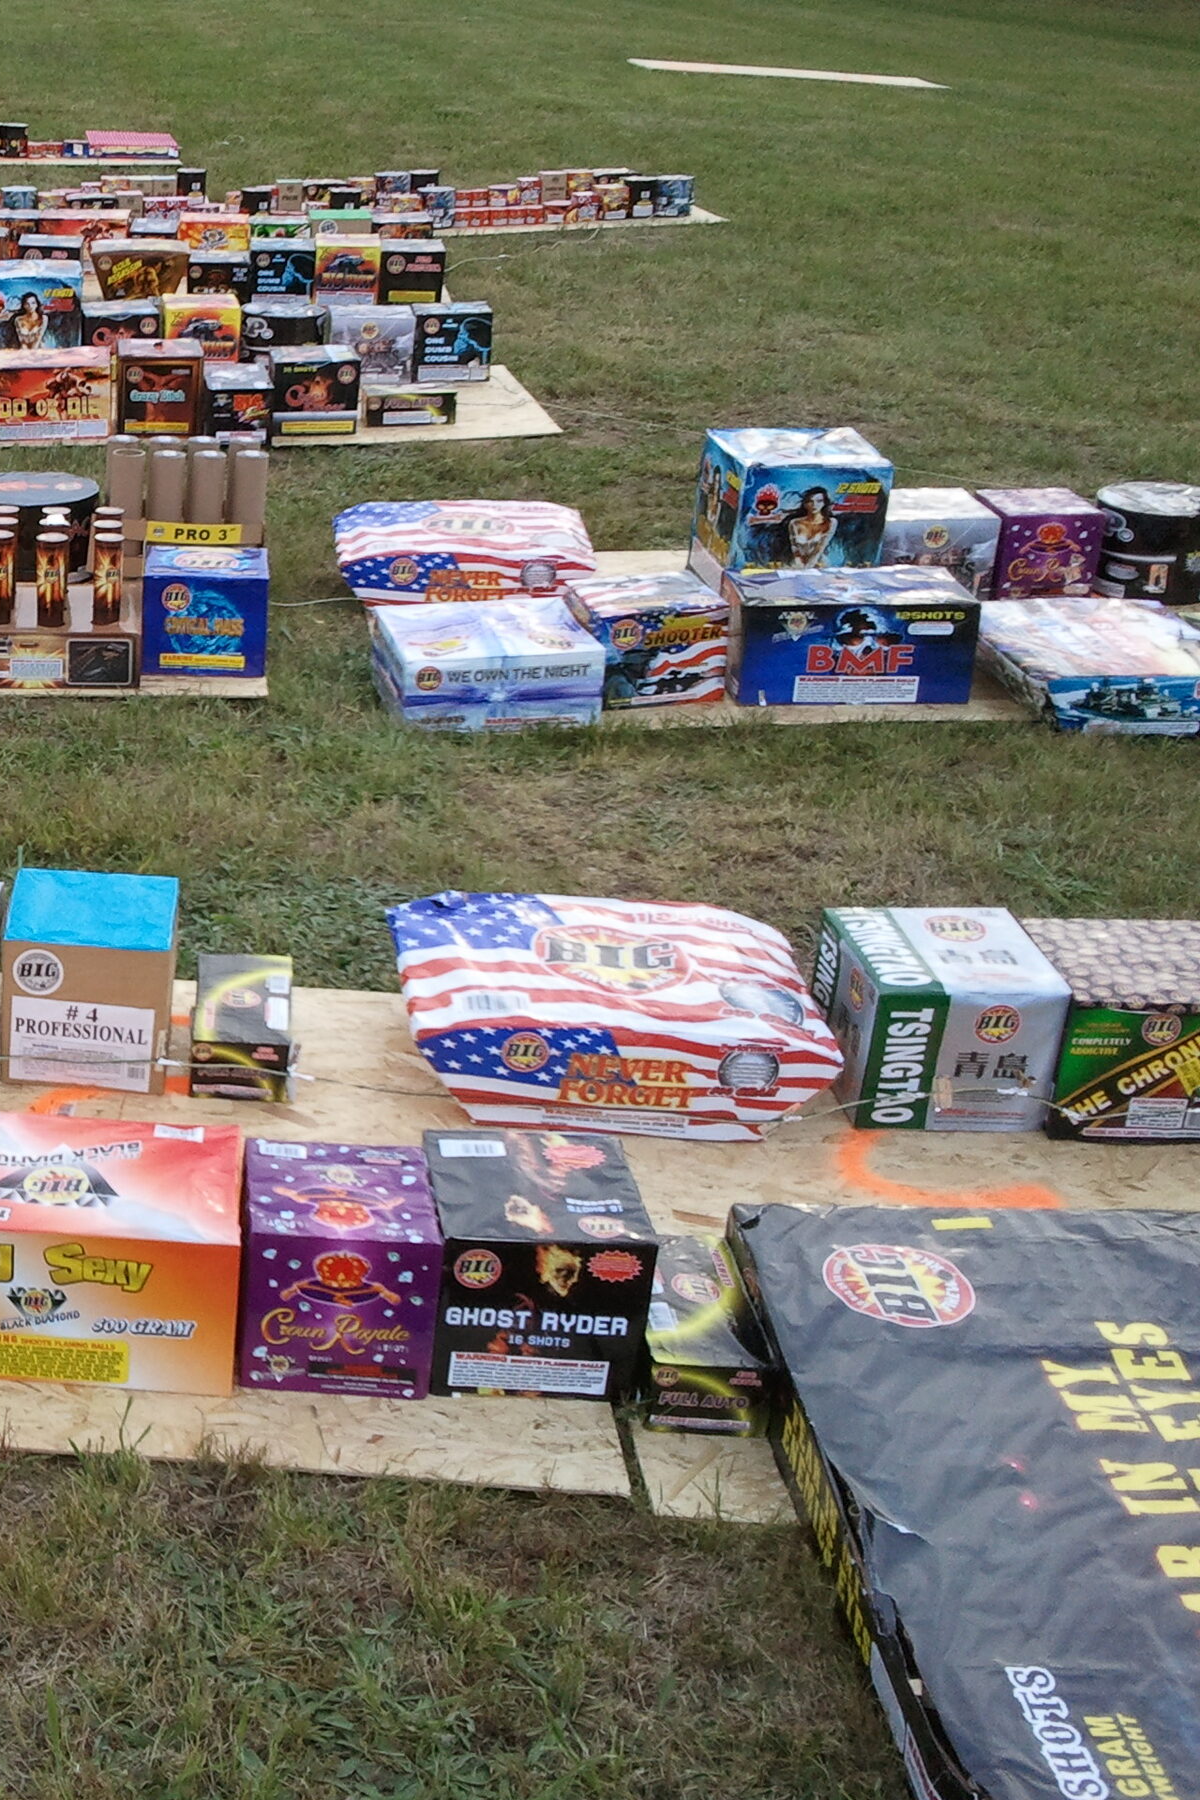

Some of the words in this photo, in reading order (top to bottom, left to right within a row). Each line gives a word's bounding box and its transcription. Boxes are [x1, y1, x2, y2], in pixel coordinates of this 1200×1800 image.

[425, 346, 451, 354] DUMB
[0, 398, 27, 418] DO
[174, 528, 211, 540] PRO
[428, 570, 501, 588] NEVER
[611, 629, 643, 642] BIG
[644, 625, 722, 648] SHOOTER
[806, 644, 916, 674] BMF
[447, 670, 472, 683] WE
[473, 668, 510, 682] OWN
[510, 667, 541, 681] THE
[542, 664, 592, 679] NIGHT
[543, 936, 676, 970] BIG
[19, 962, 58, 978] BIG
[66, 1005, 79, 1019] #
[85, 1008, 99, 1023] 4
[978, 1014, 1016, 1030] BIG
[14, 1016, 149, 1045] PROFESSIONAL
[1146, 1018, 1175, 1032] BIG
[504, 1043, 545, 1058] BIG
[1071, 1037, 1133, 1046] COMPLETELY
[567, 1053, 691, 1084] NEVER
[870, 1007, 936, 1124] TSINGTAO
[953, 1051, 1030, 1079] 青島
[557, 1078, 694, 1109] FORGET
[71, 1141, 141, 1160] BLACK
[43, 1242, 153, 1293] Sexy
[459, 1258, 497, 1274] BIG
[849, 1250, 942, 1322] BIG
[0, 1319, 33, 1330] BLACK
[35, 1310, 81, 1326] DIAMOND
[91, 1317, 127, 1334] 500
[129, 1319, 197, 1338] GRAM
[445, 1306, 533, 1330] GHOST
[541, 1311, 629, 1337] RYDER
[260, 1307, 327, 1345] Crown
[308, 1313, 412, 1355] Royale
[508, 1335, 524, 1345] 16
[527, 1335, 571, 1348] SHOTS
[455, 1353, 508, 1363] WARNING
[510, 1357, 543, 1365] SHOOTS
[543, 1359, 579, 1368] FLAMING
[658, 1391, 699, 1407] FULL
[700, 1394, 749, 1409] AUTO
[1040, 1359, 1151, 1433] MY
[1098, 1458, 1200, 1516] IN
[1005, 1665, 1109, 1800] SHOTS
[1083, 1716, 1152, 1798] GRAM
